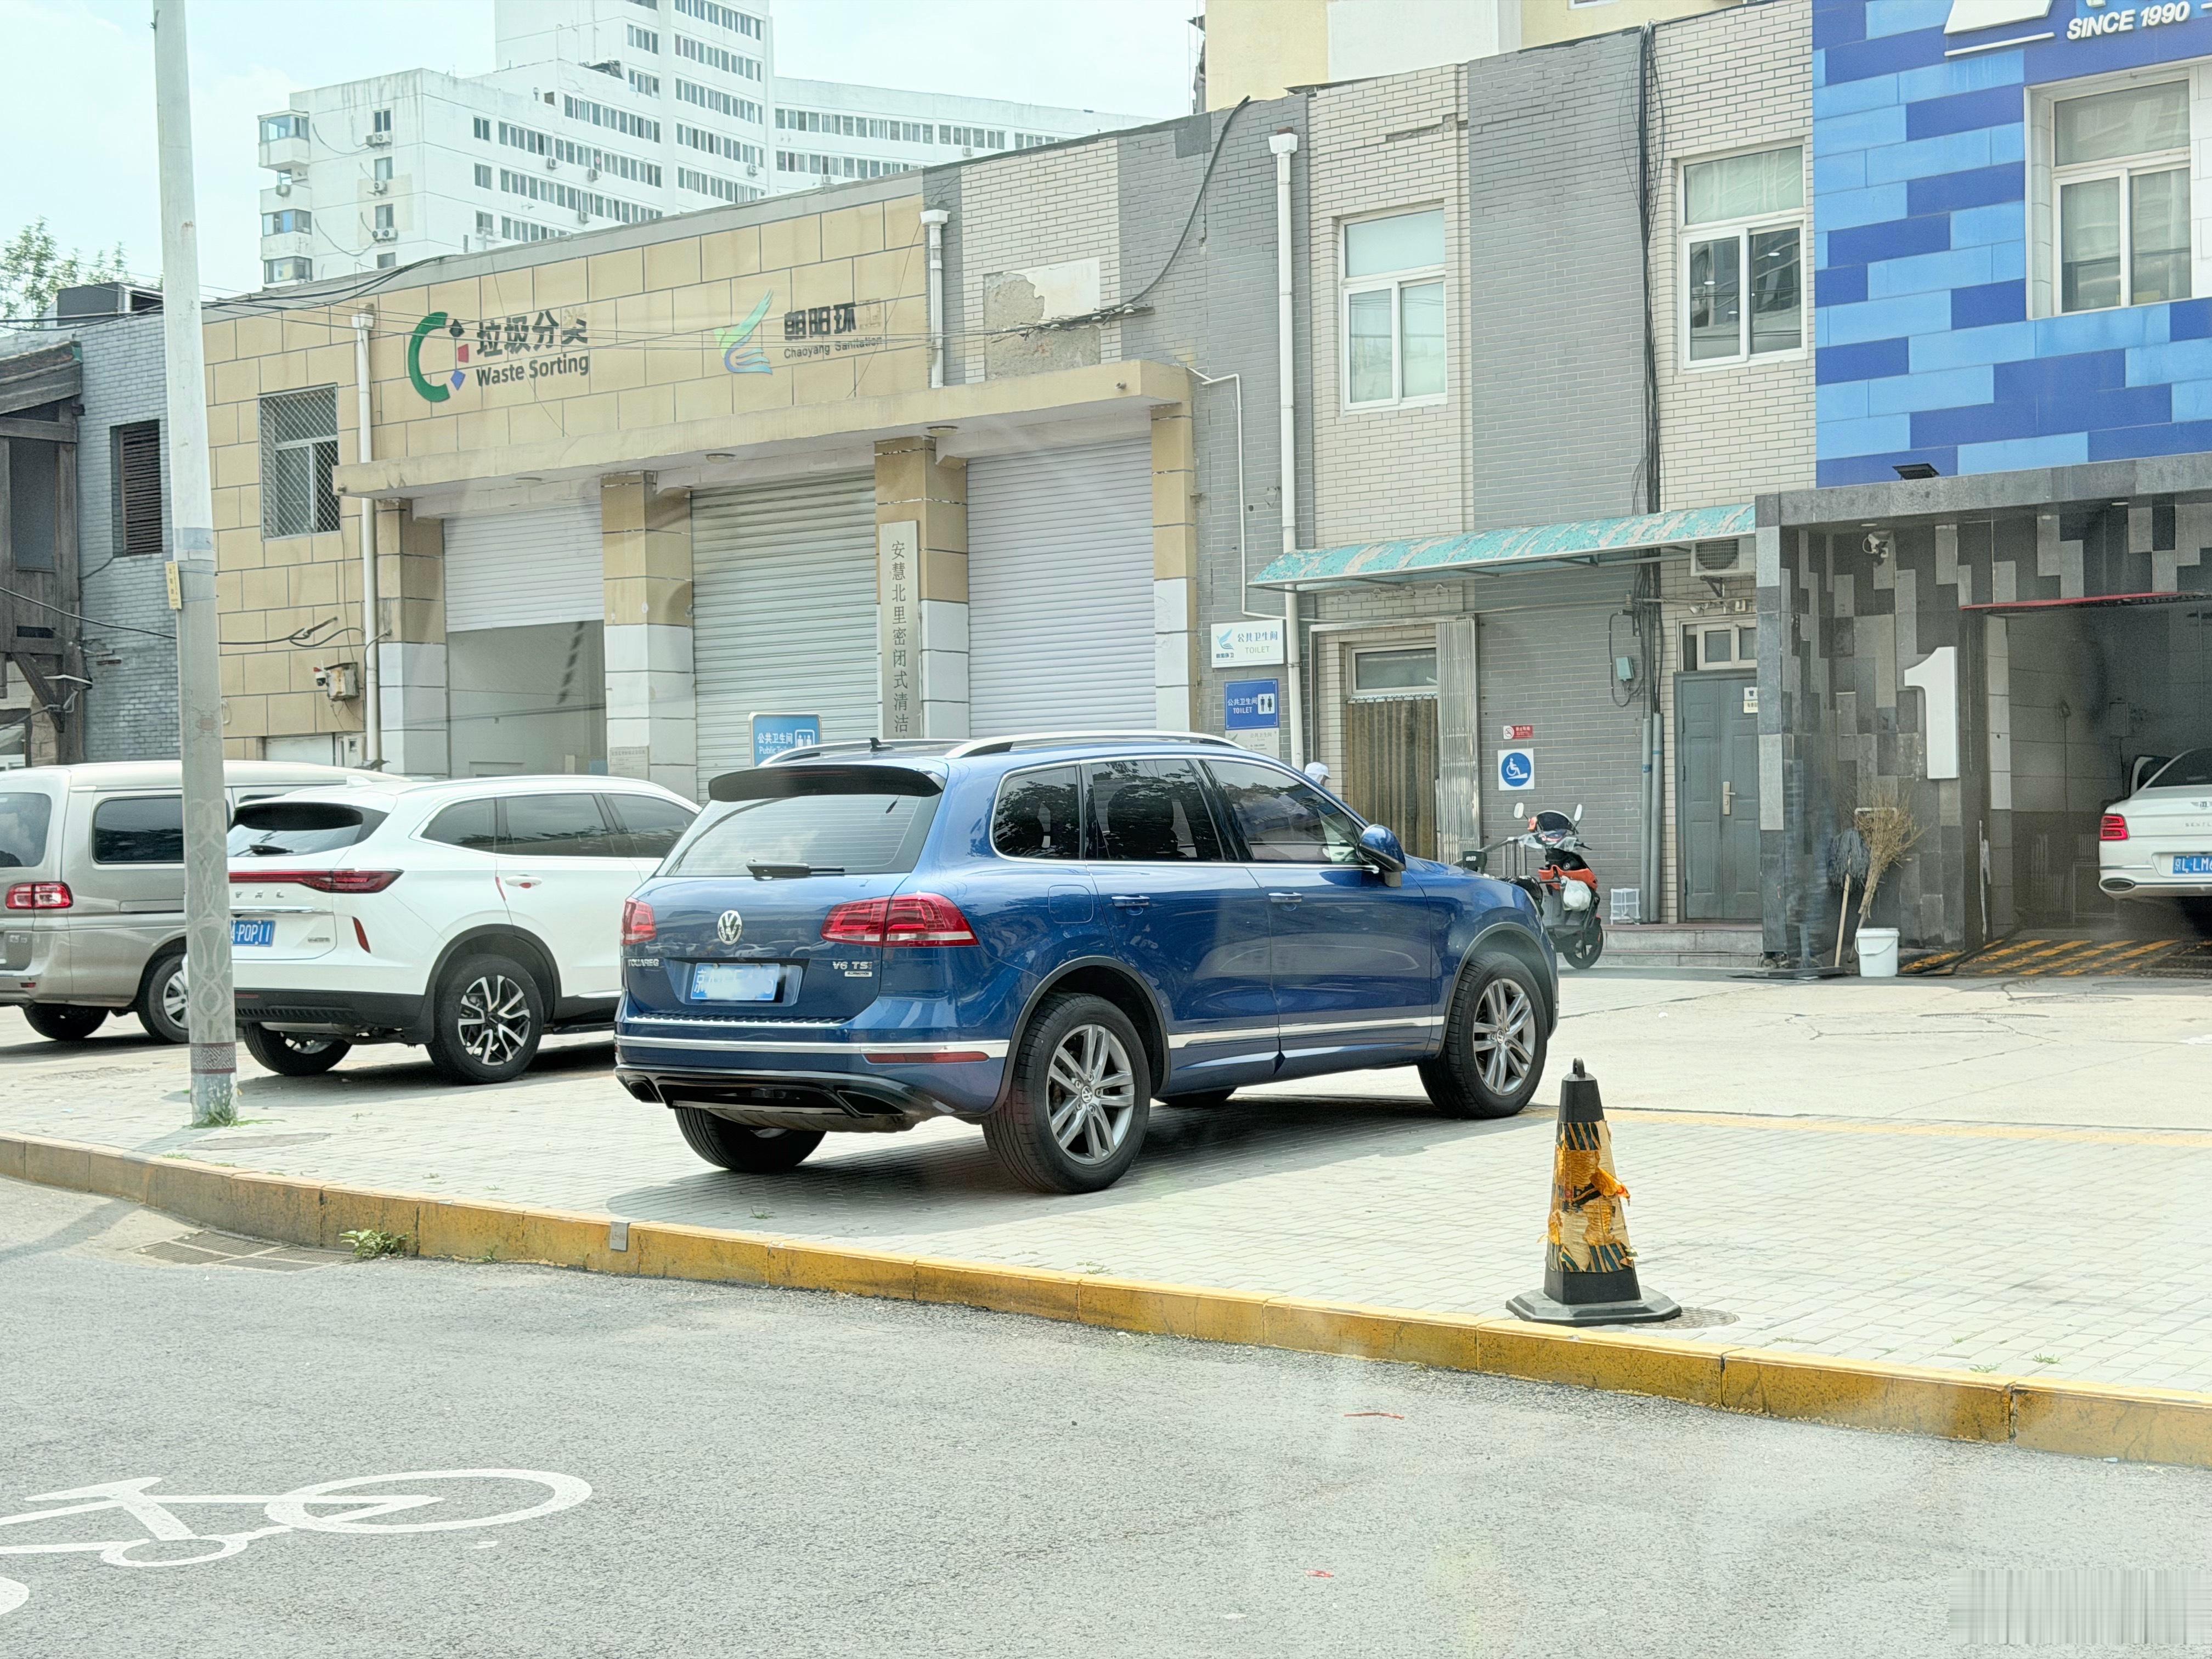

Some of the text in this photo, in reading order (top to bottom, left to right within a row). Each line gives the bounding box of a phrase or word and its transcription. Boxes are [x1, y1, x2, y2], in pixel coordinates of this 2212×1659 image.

[2067, 1, 2191, 40] SINCE 1990
[784, 336, 882, 359] Chaoyang Sanitation
[476, 354, 589, 387] Waste Sorting
[890, 540, 909, 738] 安慧北里密闭式清洁
[1238, 631, 1278, 642] 公共卫生间
[1244, 646, 1270, 654] TOILET
[1227, 697, 1257, 706] 公共卫生间
[1904, 646, 1959, 780] 1
[758, 732, 793, 744] 公共卫生间
[832, 961, 873, 970] V6 TSI
